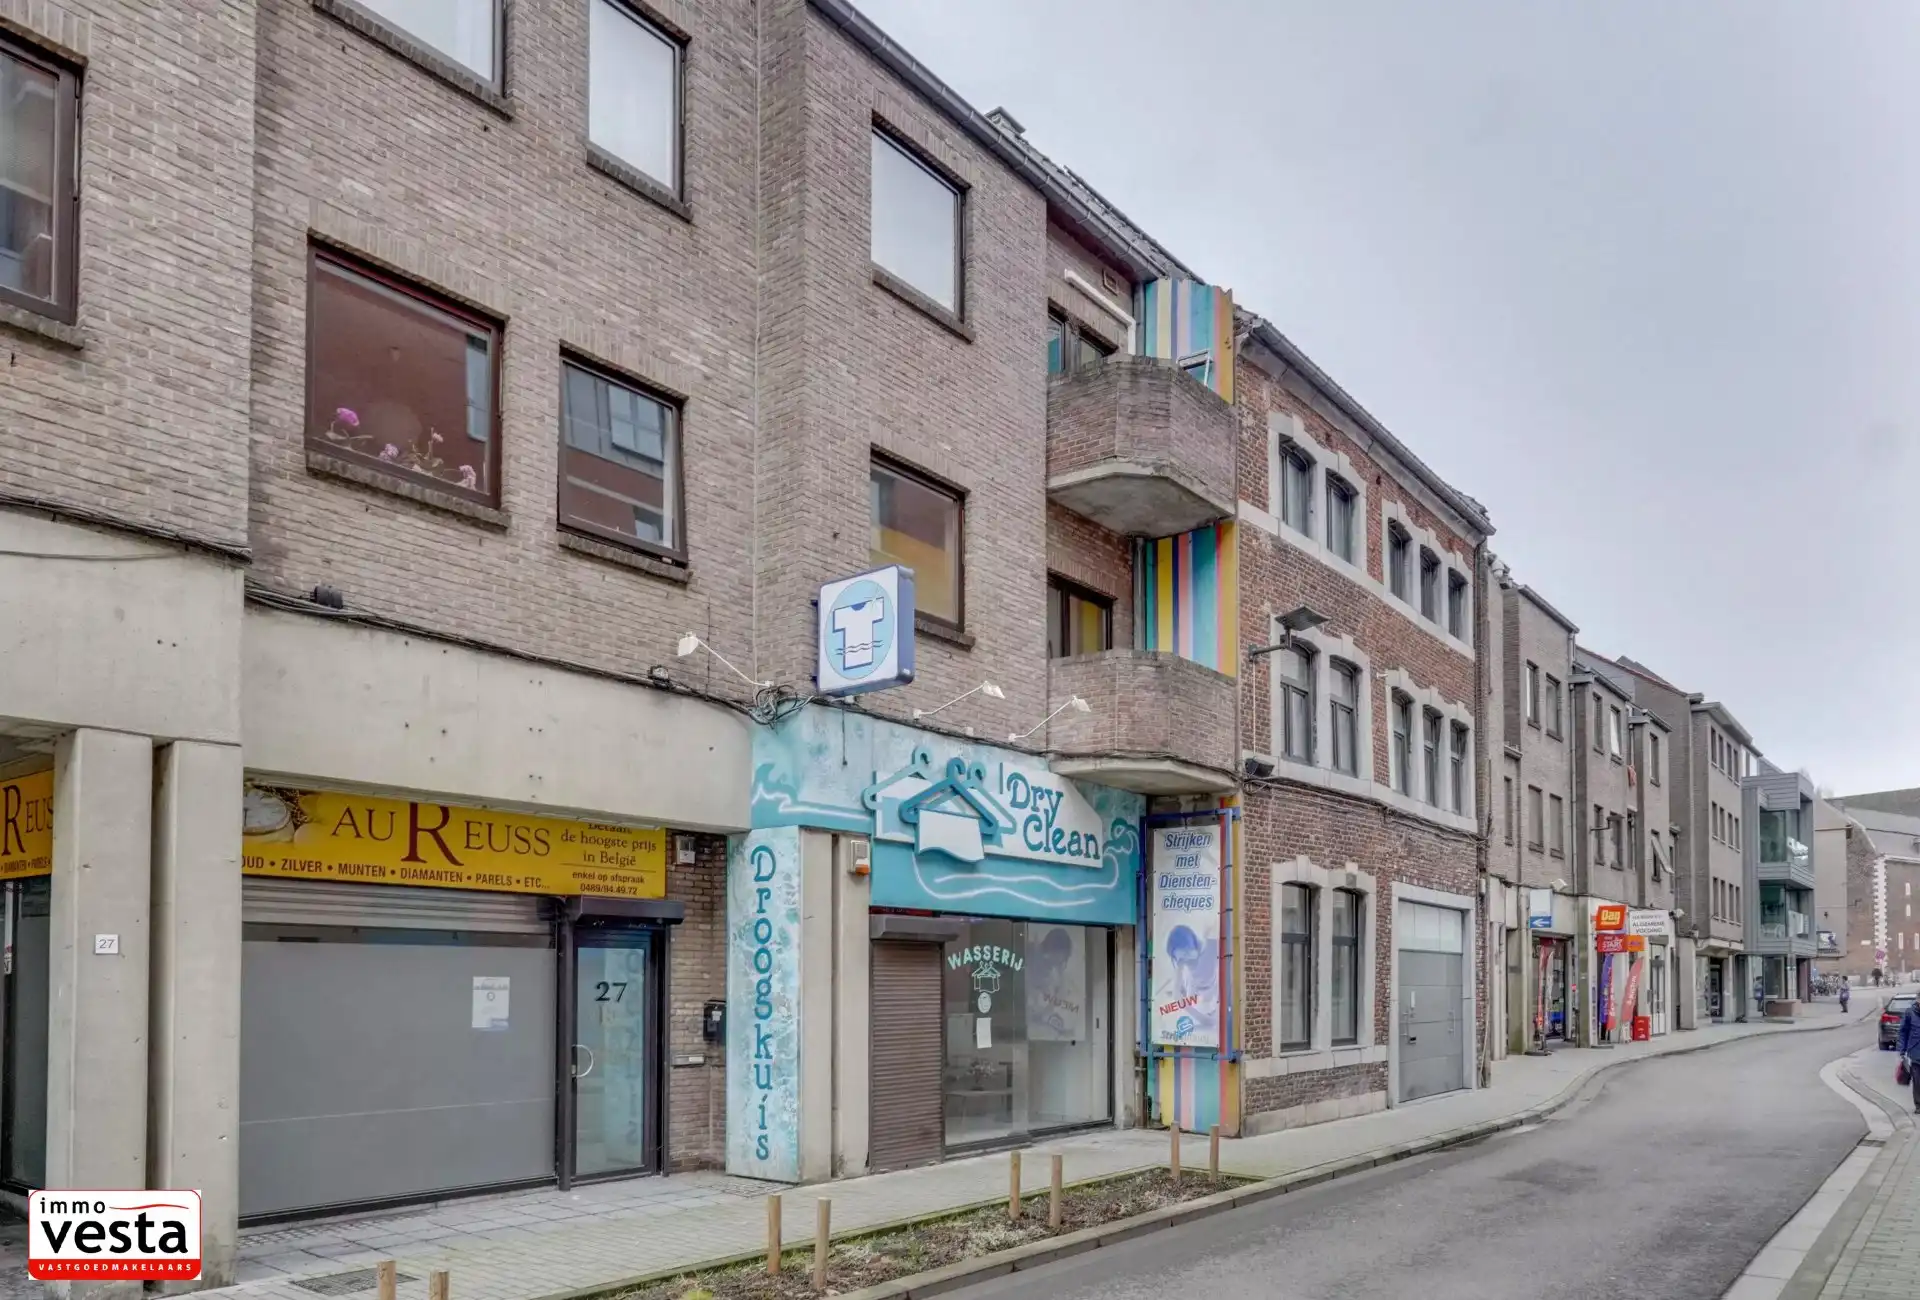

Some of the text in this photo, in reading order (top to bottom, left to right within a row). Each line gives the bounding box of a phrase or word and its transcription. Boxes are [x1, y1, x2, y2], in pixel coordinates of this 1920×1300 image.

[1006, 771, 1064, 829] Dry
[331, 806, 396, 841] AU
[1023, 808, 1101, 860] Clean
[561, 828, 657, 854] de hoogste prijs
[1165, 832, 1212, 851] Strijken
[583, 851, 637, 868] in België
[1176, 853, 1200, 868] met
[281, 858, 322, 873] ZILVER
[338, 863, 386, 877] MUNTEN
[400, 867, 464, 882] DIAMANTEN
[476, 872, 513, 886] PARELS
[572, 870, 596, 881] enkel
[597, 873, 609, 884] op
[1159, 873, 1217, 889] Diensten-
[1163, 893, 1214, 910] cheques
[97, 938, 116, 949] 27
[947, 944, 1024, 972] WASSERIJ
[594, 981, 627, 1003] 27
[1160, 994, 1198, 1015] NIEUW
